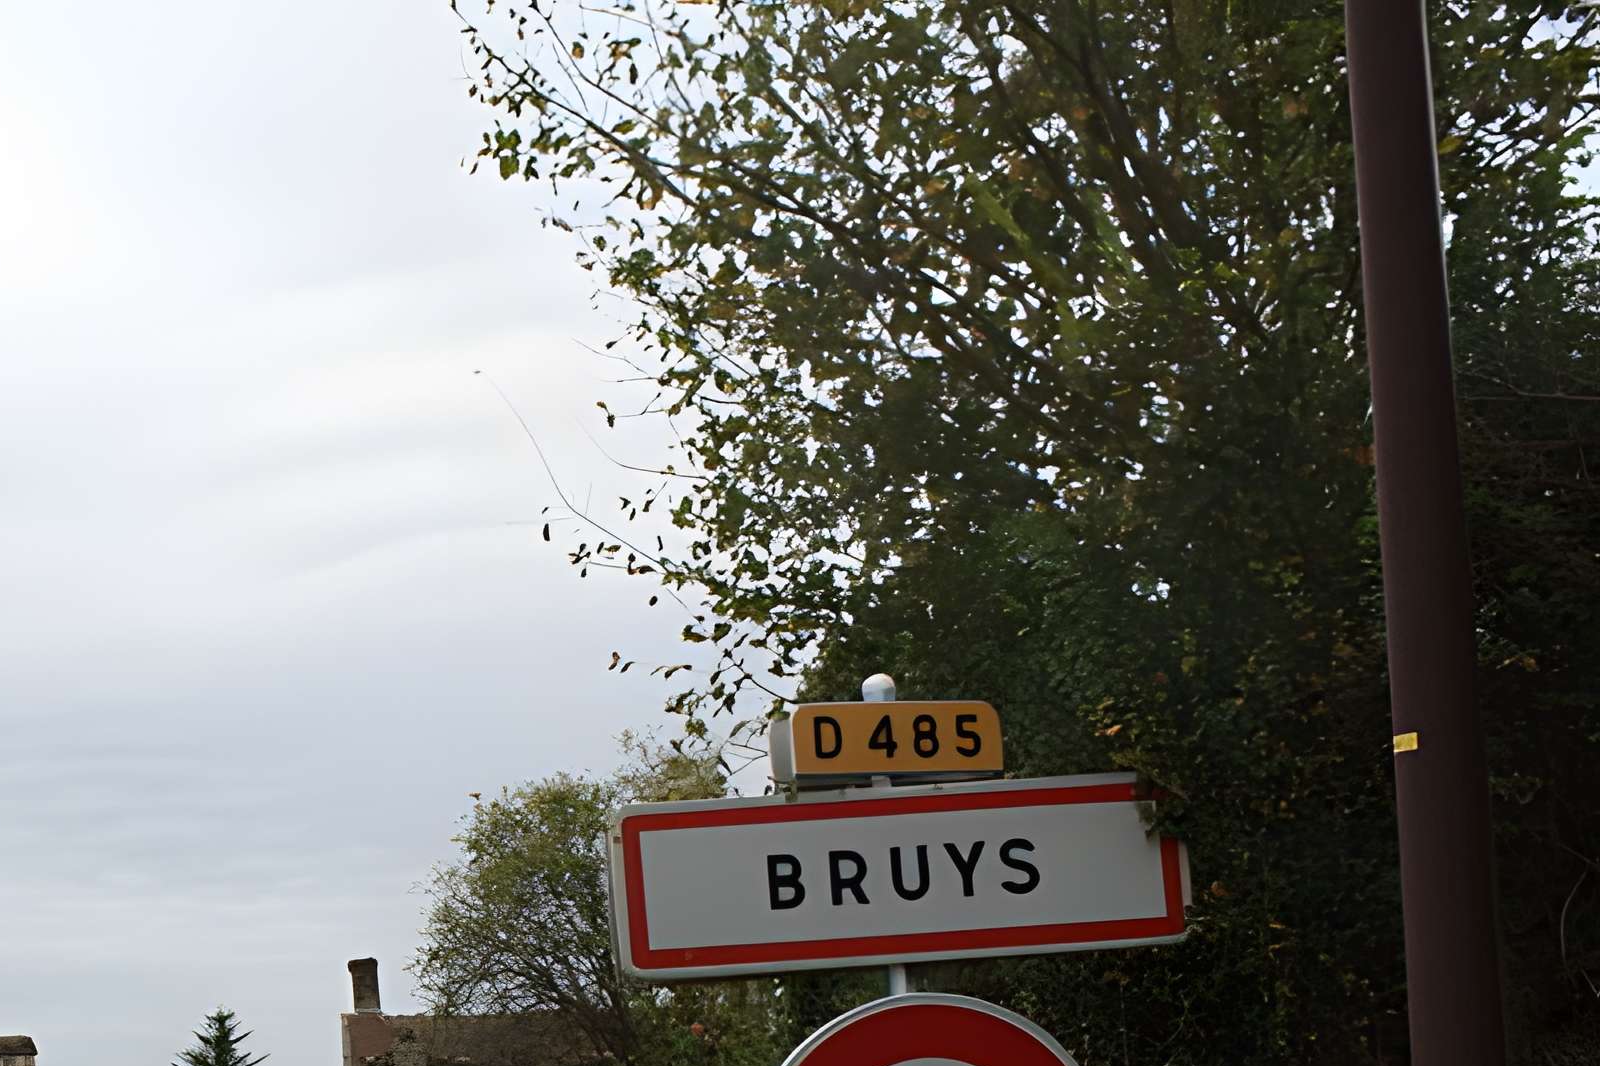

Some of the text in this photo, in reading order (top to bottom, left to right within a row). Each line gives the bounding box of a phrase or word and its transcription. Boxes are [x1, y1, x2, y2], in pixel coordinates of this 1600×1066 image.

[814, 714, 982, 759] D 485
[767, 838, 1040, 910] BRUYS
